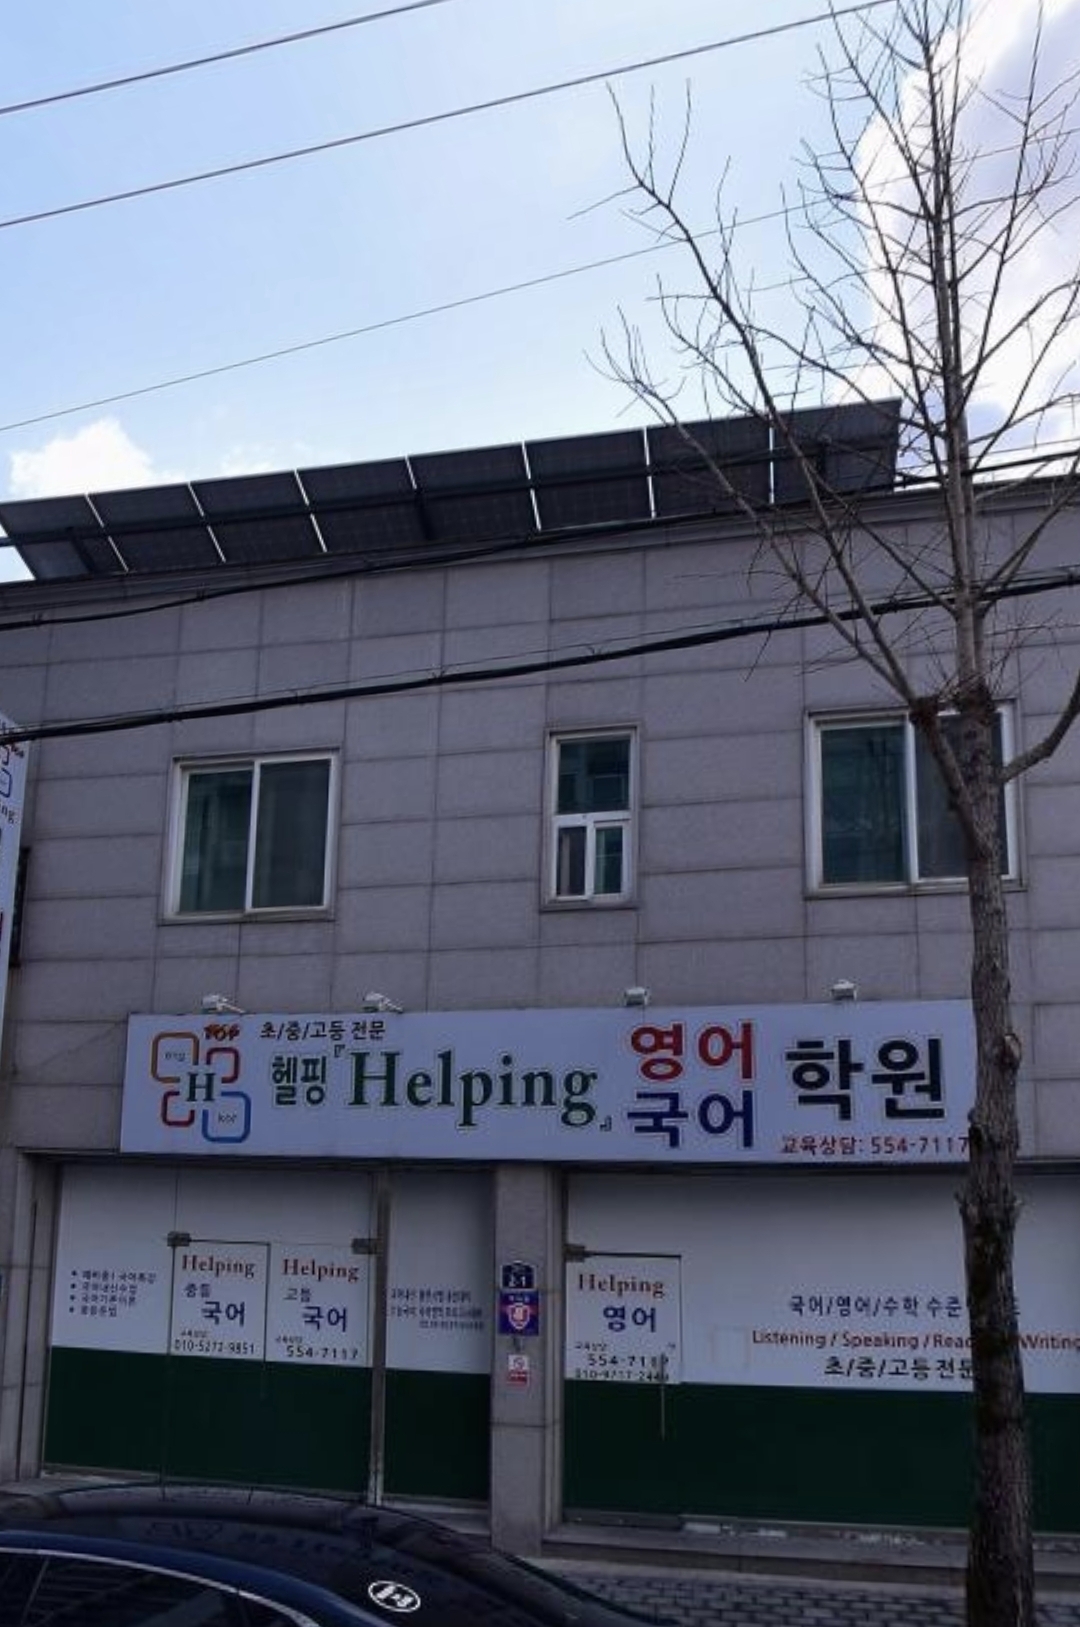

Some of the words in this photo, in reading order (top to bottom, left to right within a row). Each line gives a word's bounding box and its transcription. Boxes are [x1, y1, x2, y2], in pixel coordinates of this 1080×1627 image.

[351, 1021, 386, 1040] 전문
[631, 1023, 751, 1081] 영어
[186, 1072, 216, 1102] H
[272, 1056, 326, 1105] 헬핑
[786, 1038, 945, 1120] 학원
[627, 1090, 753, 1147] 국어
[871, 1136, 968, 1156] 554-7117
[182, 1254, 256, 1279] Helping
[281, 1258, 360, 1284] Helping
[578, 1273, 666, 1299] Helping
[201, 1301, 246, 1328] 국어
[302, 1305, 348, 1333] 국어
[603, 1305, 657, 1333] 영어
[789, 1295, 919, 1318] 국어/영어/수학
[752, 1330, 825, 1348] Listening
[842, 1331, 920, 1351] Speaking
[824, 1355, 930, 1378] 초/중/고등
